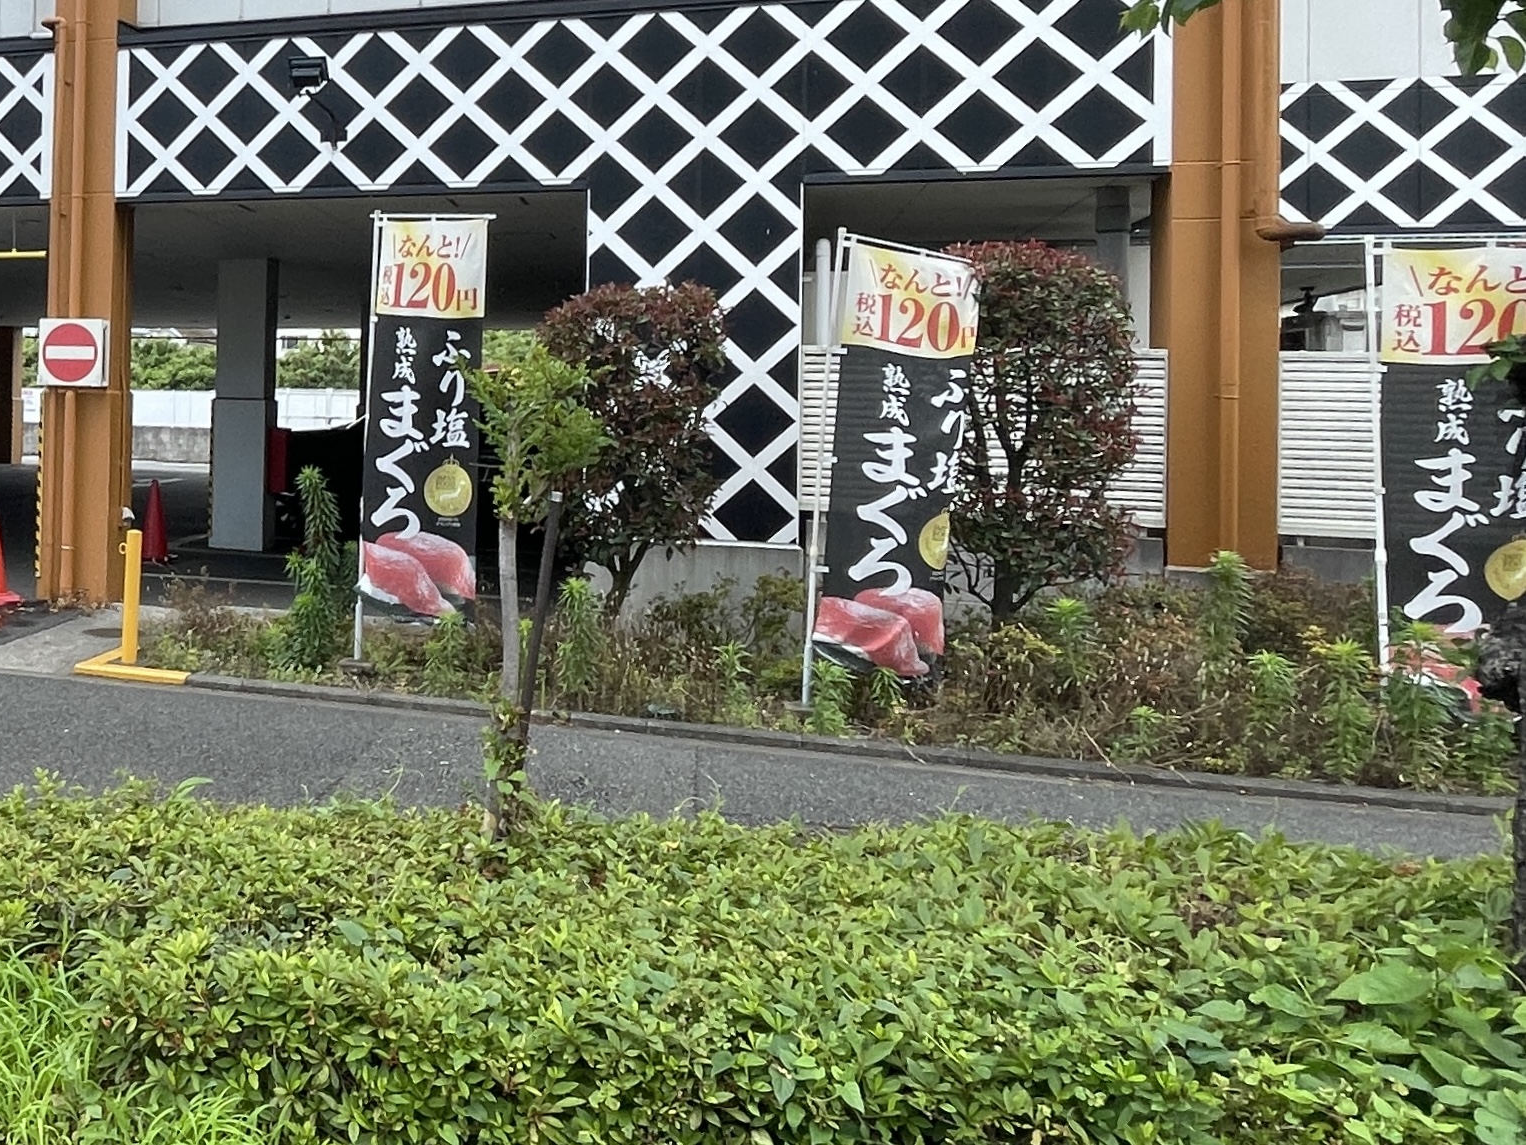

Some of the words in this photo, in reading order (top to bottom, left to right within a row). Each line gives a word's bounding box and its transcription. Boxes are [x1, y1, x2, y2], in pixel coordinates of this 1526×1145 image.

[390, 261, 478, 313] 120円
[853, 292, 876, 337] 税込
[1392, 304, 1423, 353] 税込
[429, 330, 472, 449] ふり塩
